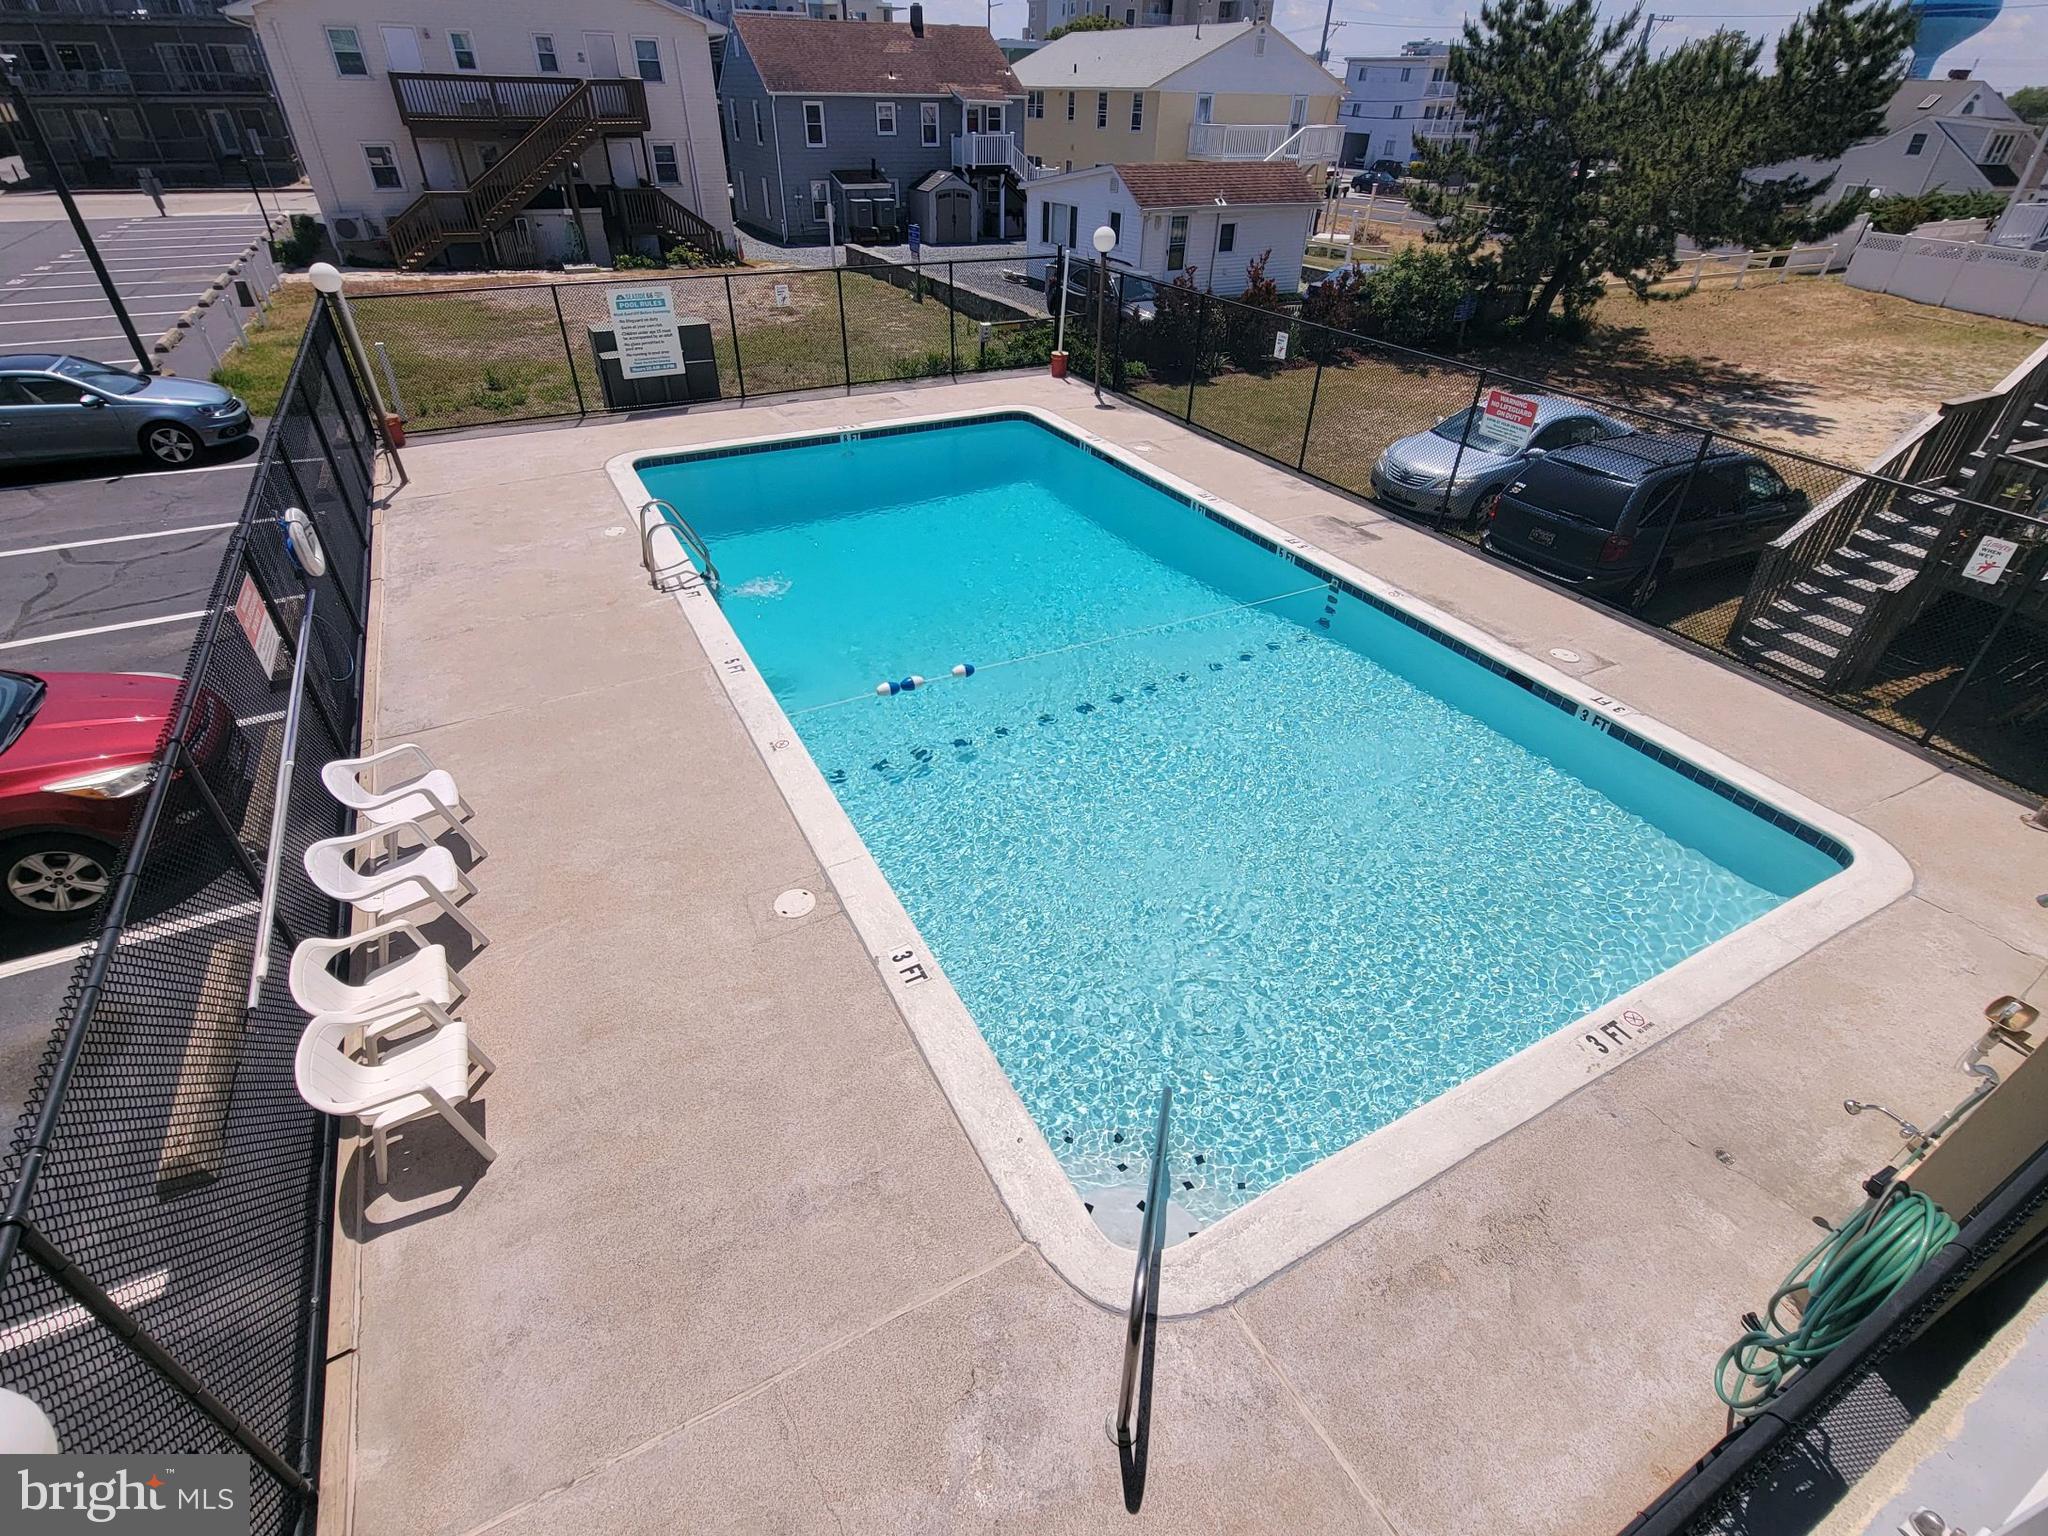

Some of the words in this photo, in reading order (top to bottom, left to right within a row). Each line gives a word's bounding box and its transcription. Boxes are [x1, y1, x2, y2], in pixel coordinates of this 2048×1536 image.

[1500, 395, 1528, 409] WARNING
[1496, 410, 1506, 418] ON
[1506, 412, 1523, 422] DUTY
[1500, 402, 1533, 418] LIFEGUARD
[850, 432, 859, 442] FT
[1286, 551, 1296, 564] FT
[1979, 552, 1994, 560] WET
[1982, 548, 2002, 556] WHEN
[728, 664, 746, 674] FT
[1590, 696, 1612, 706] FT
[1580, 708, 1590, 722] 3
[1592, 714, 1610, 732] FT
[892, 950, 914, 962] 3
[899, 963, 928, 984] FT
[1586, 1034, 1609, 1054] 3
[1600, 1020, 1632, 1046] FT
